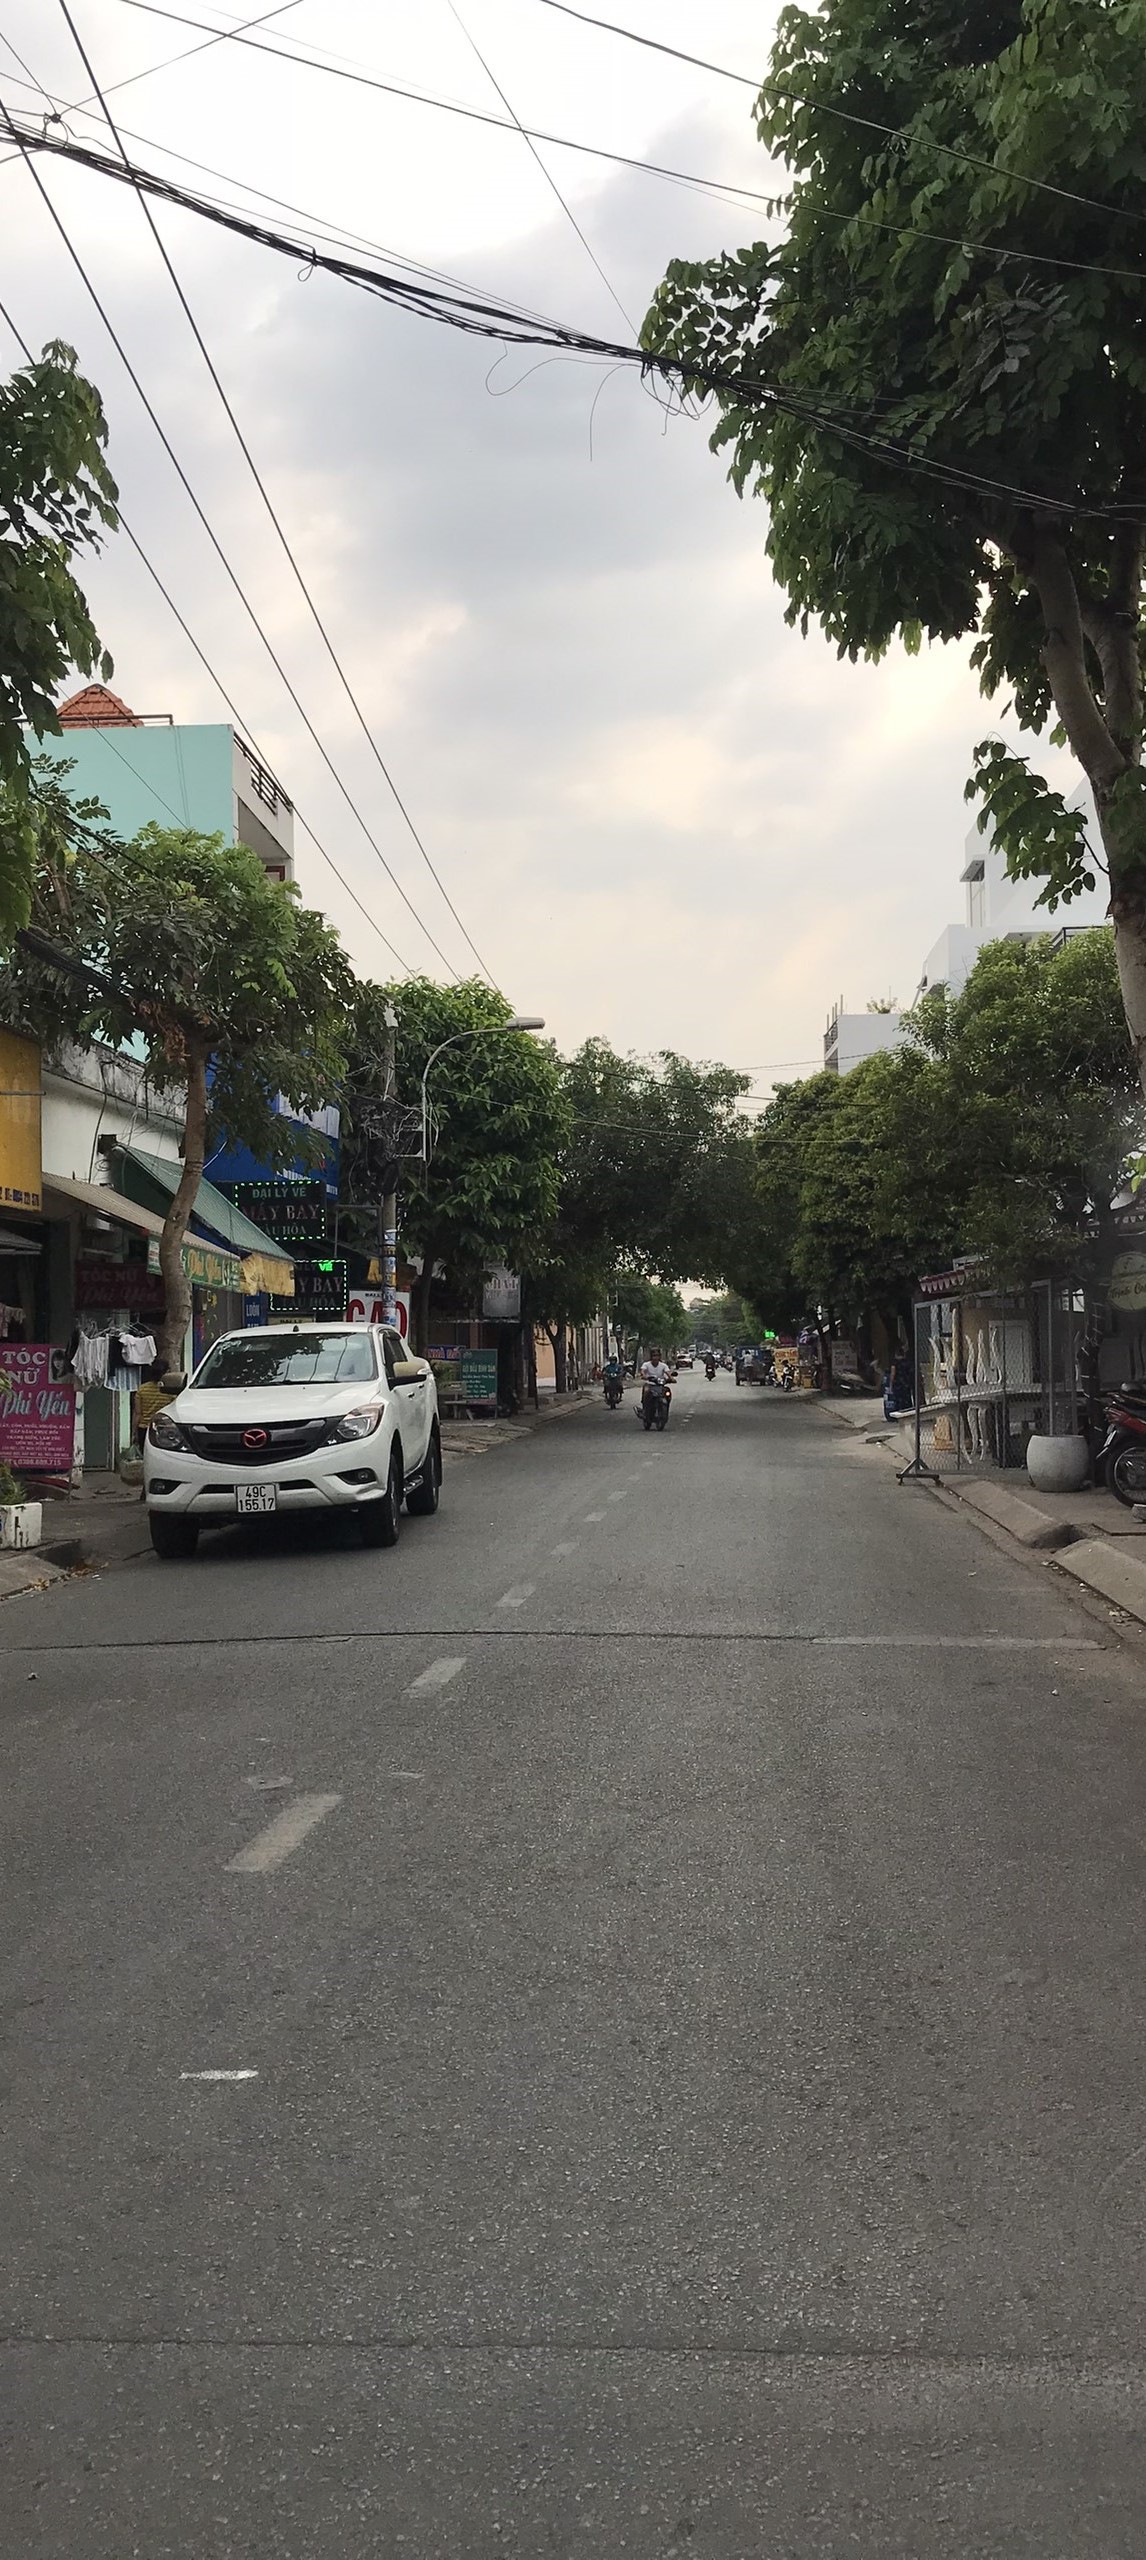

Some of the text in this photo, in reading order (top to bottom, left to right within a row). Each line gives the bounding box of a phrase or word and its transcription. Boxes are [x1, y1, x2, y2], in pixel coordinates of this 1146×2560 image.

[286, 1204, 320, 1220] BAY
[2, 1347, 47, 1365] TÓC
[7, 1367, 40, 1385] NỮ
[36, 1390, 69, 1421] Yến
[246, 1486, 266, 1498] 49C
[239, 1498, 274, 1511] 155.17
